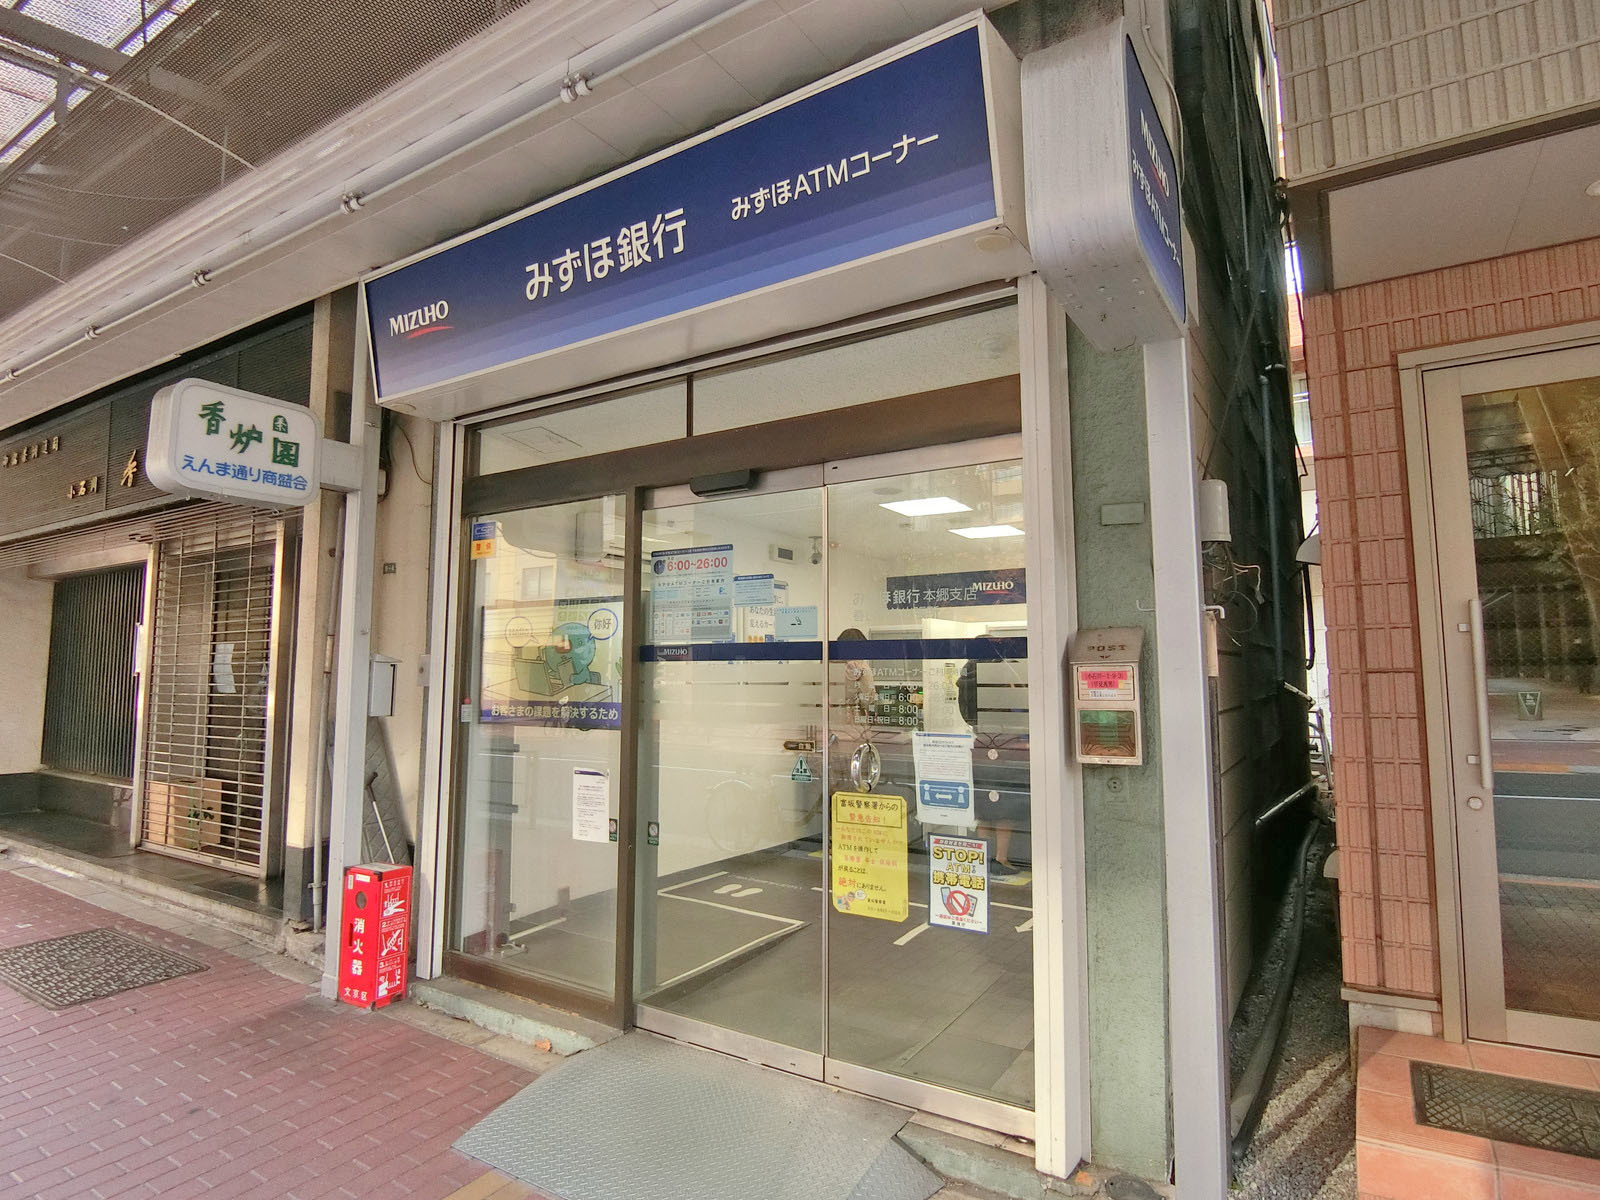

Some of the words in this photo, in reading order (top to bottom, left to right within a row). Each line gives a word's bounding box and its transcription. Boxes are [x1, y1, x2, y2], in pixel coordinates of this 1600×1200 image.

[731, 134, 938, 220] みずほATMコーナー
[525, 208, 687, 300] みずほ銀行
[390, 301, 449, 336] MIZUHO
[182, 455, 308, 491] えんま通り商盛会
[973, 581, 1014, 592] MIZUHO
[933, 846, 985, 866] STOP!
[933, 870, 985, 891] 携帯電話
[352, 918, 365, 976] 消火器
